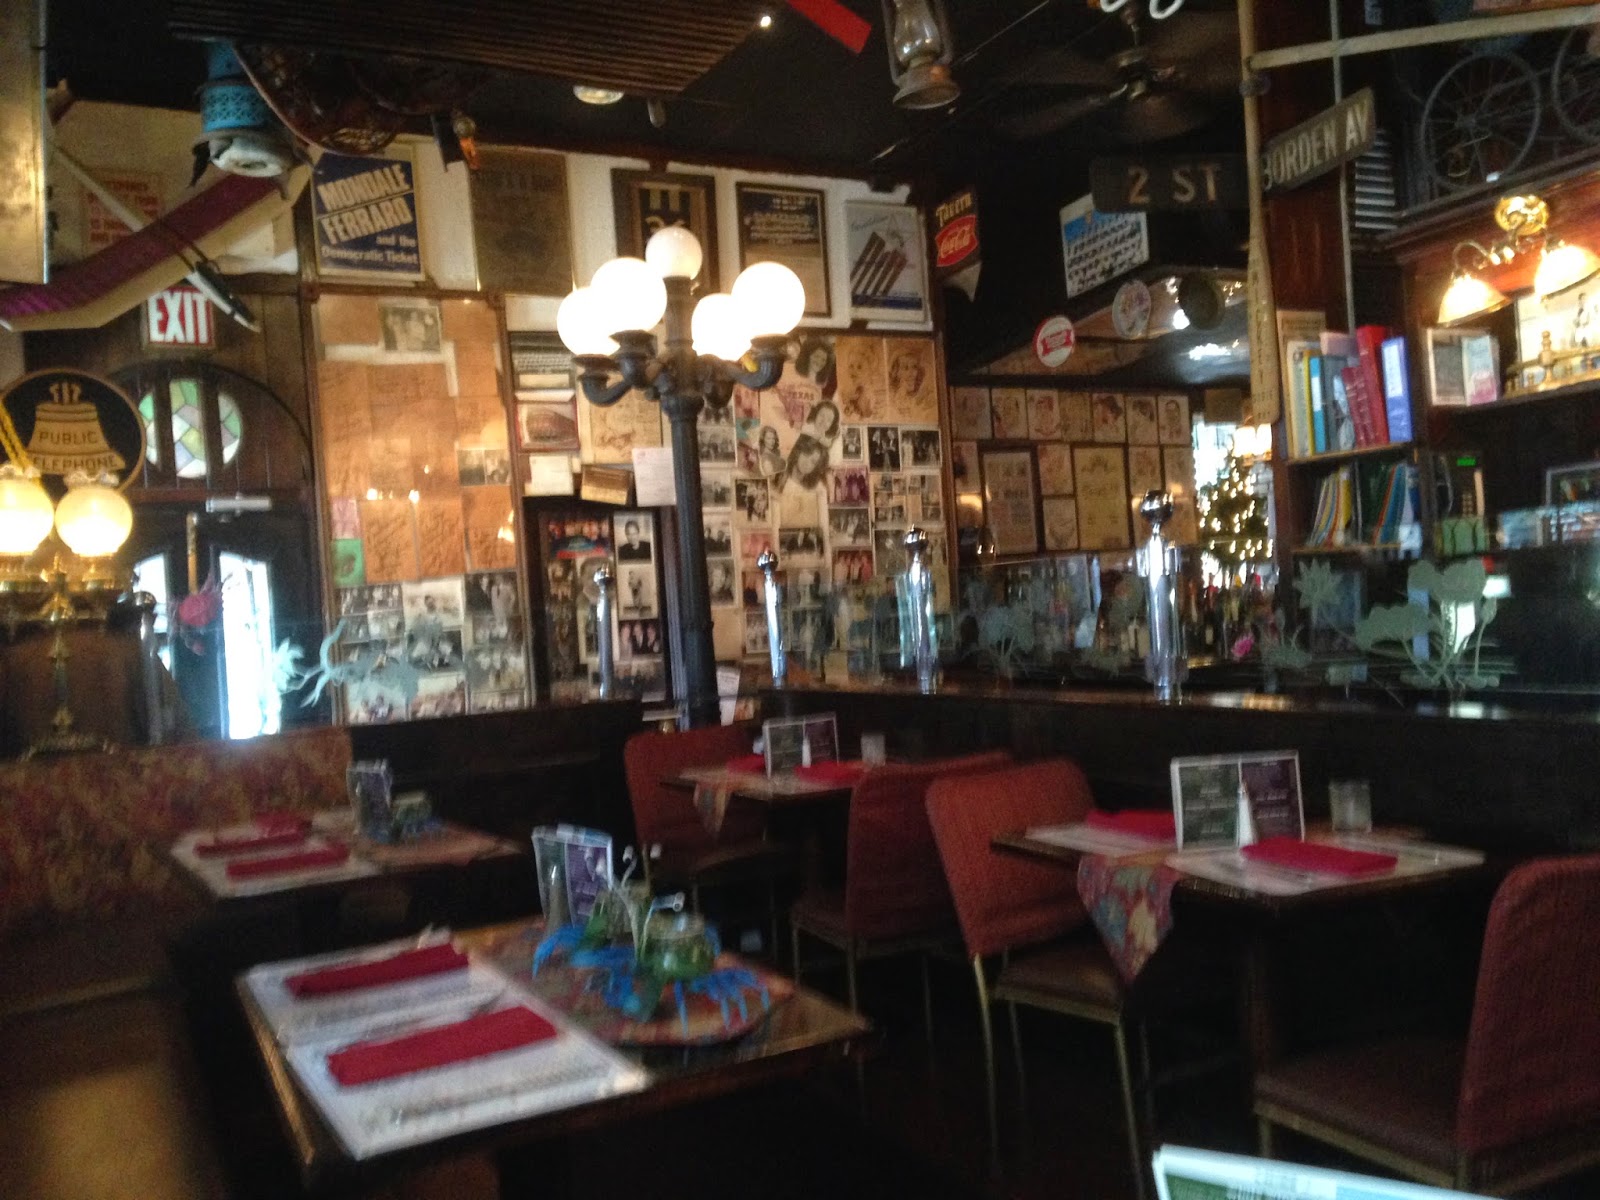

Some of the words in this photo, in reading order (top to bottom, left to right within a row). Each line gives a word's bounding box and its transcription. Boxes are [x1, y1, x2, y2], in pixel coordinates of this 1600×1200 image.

[1345, 100, 1374, 151] AV
[317, 164, 410, 212] MONDALE
[1128, 167, 1149, 205] 2
[1173, 162, 1220, 203] ST
[320, 197, 413, 245] FERRARO
[148, 290, 209, 344] EXIT
[39, 430, 98, 446] PUBLIC
[31, 453, 119, 474] ELEPHONE
